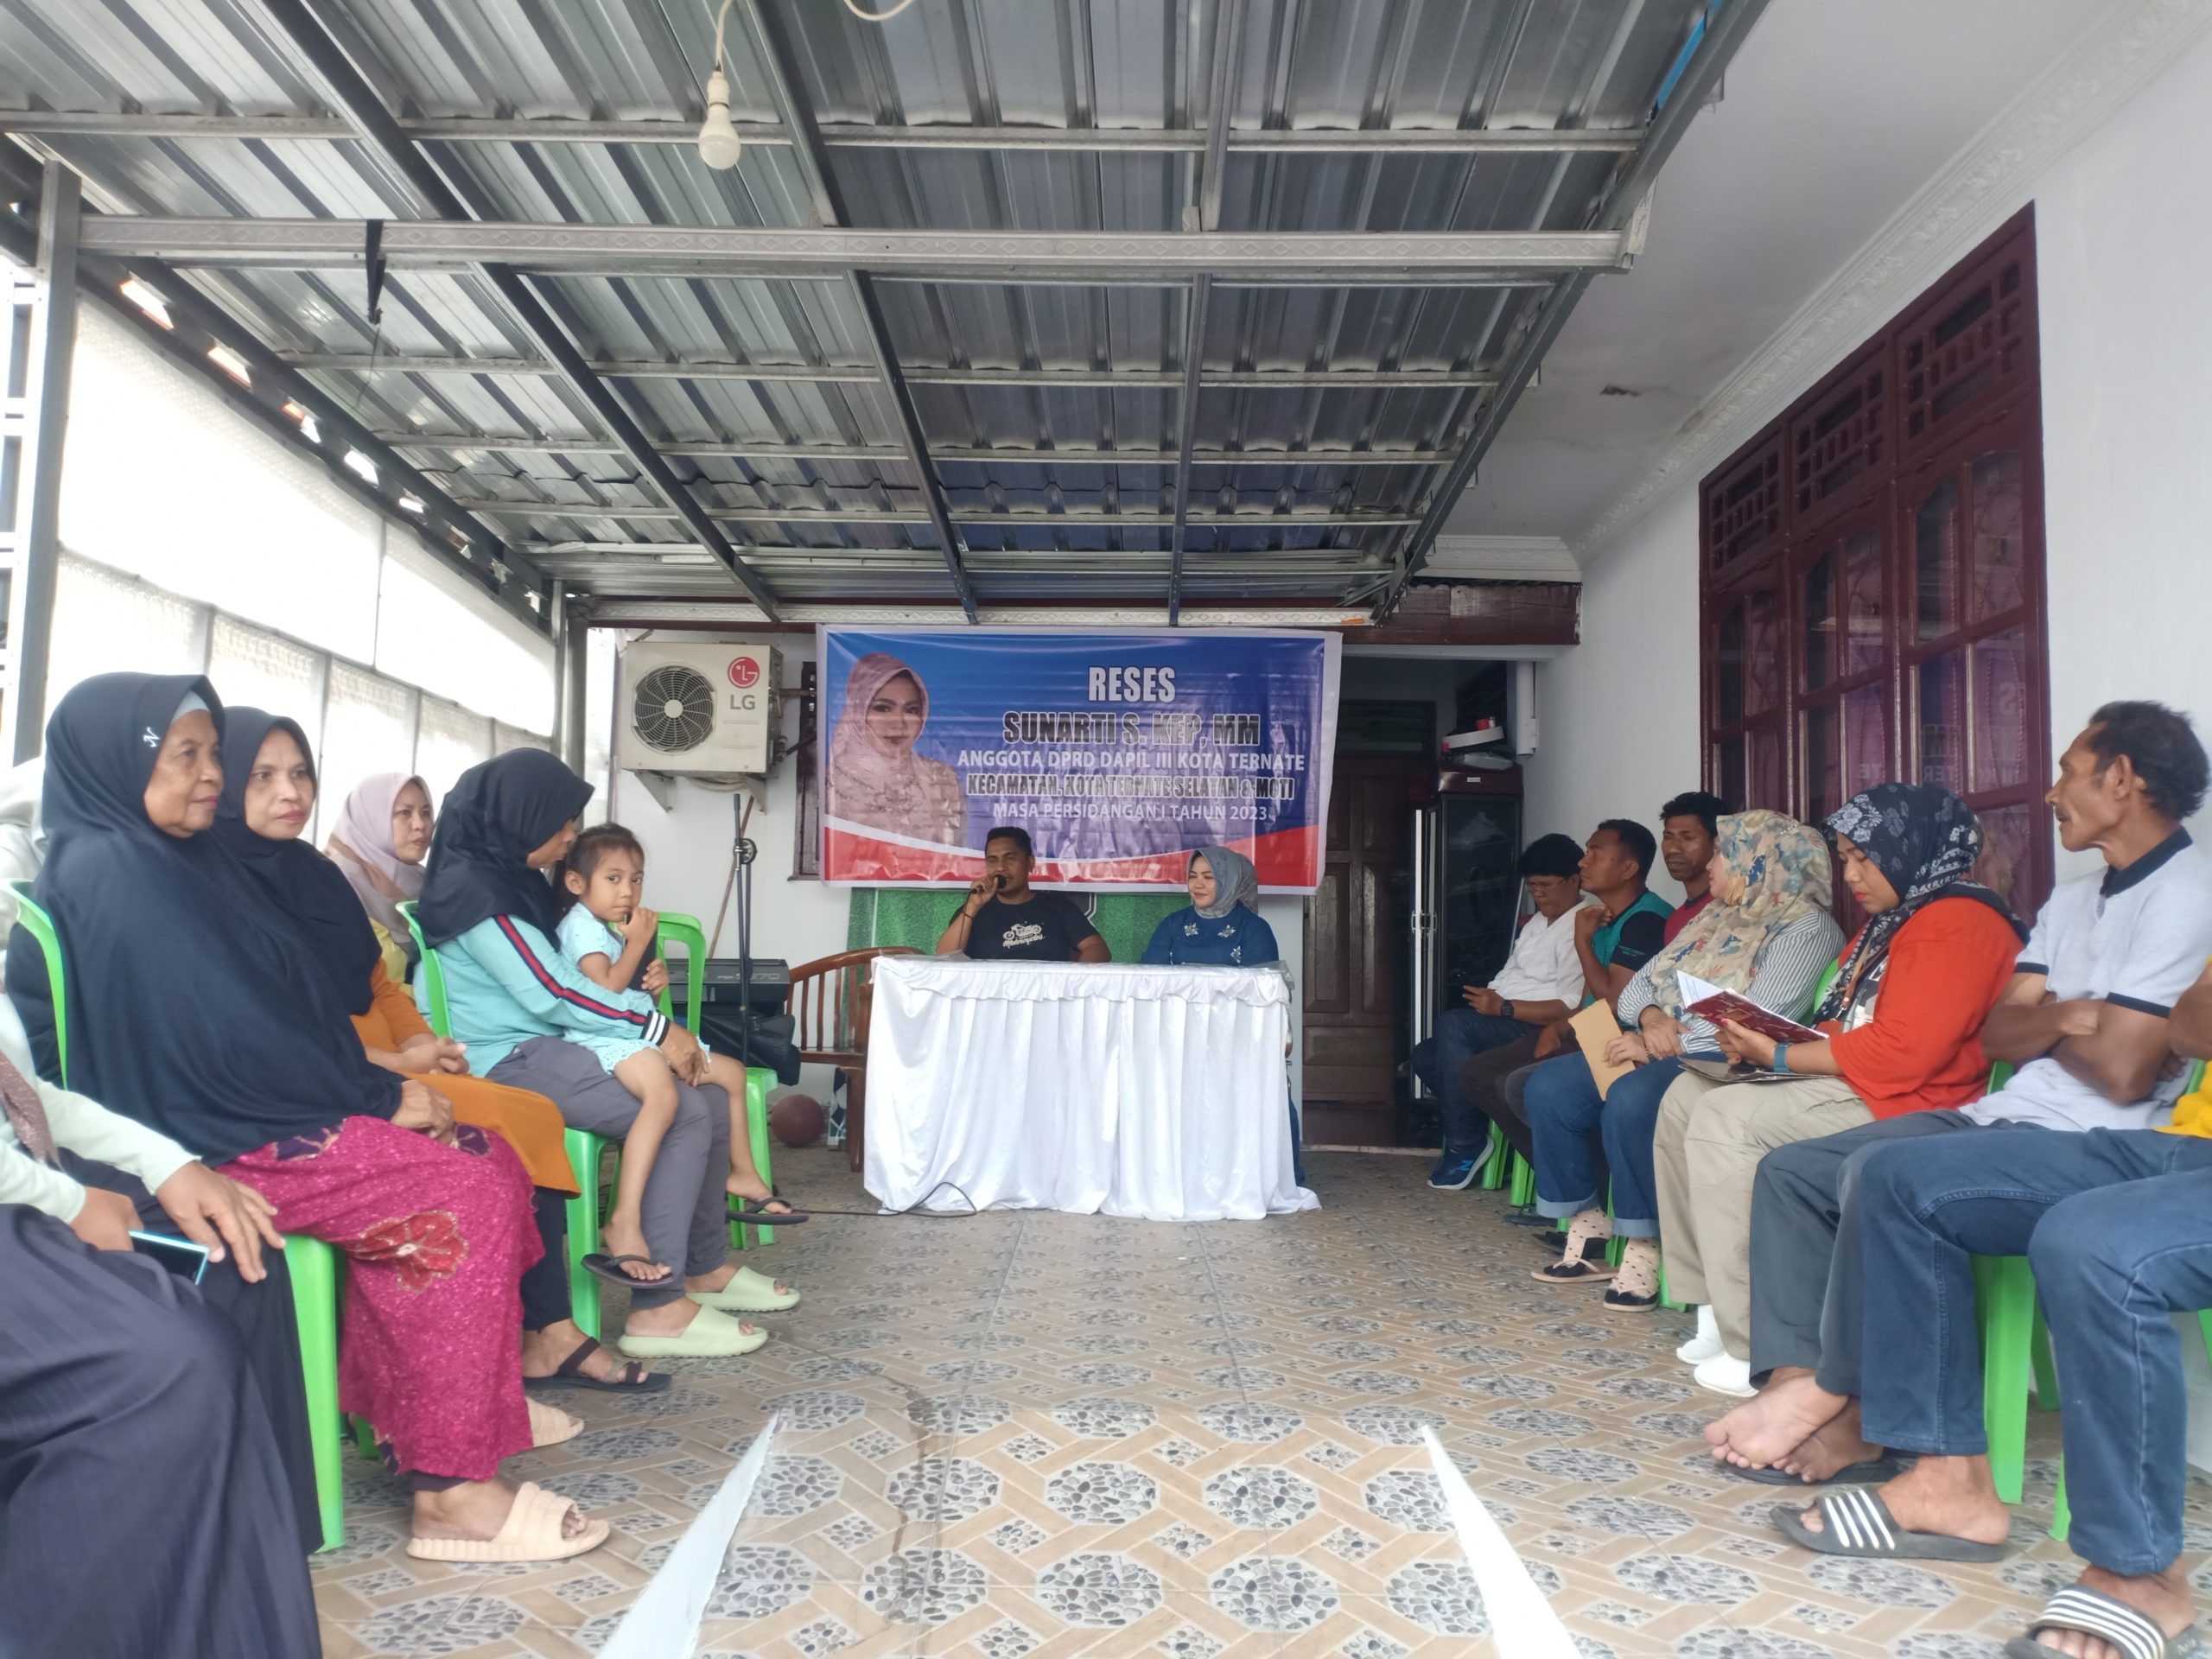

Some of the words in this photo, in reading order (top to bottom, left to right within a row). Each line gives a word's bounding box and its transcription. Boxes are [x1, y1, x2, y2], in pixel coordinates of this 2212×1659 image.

[1088, 666, 1176, 702] RESES
[730, 695, 755, 710] LG
[1003, 711, 1116, 744] SUNARTI
[1122, 712, 1147, 746] S.
[1153, 714, 1206, 748] KEP,
[1212, 714, 1261, 746] MM
[957, 750, 1043, 767] ANGGOTA
[1048, 751, 1095, 768] DPRD
[1100, 752, 1150, 768] DAPIL
[1156, 753, 1172, 769] III
[1178, 753, 1224, 769] KOTA
[1229, 753, 1306, 771] TERNATE
[1064, 775, 1105, 797] KOTA
[1106, 775, 1172, 798] TERNATE
[1173, 776, 1238, 799] SELATAN
[1240, 779, 1255, 799] &
[1255, 777, 1295, 800] MOTI
[994, 803, 1039, 818] MASA
[1044, 804, 1156, 818] PERSIDANGAN
[1170, 804, 1226, 820] TAHUN
[1230, 806, 1267, 820] 2023
